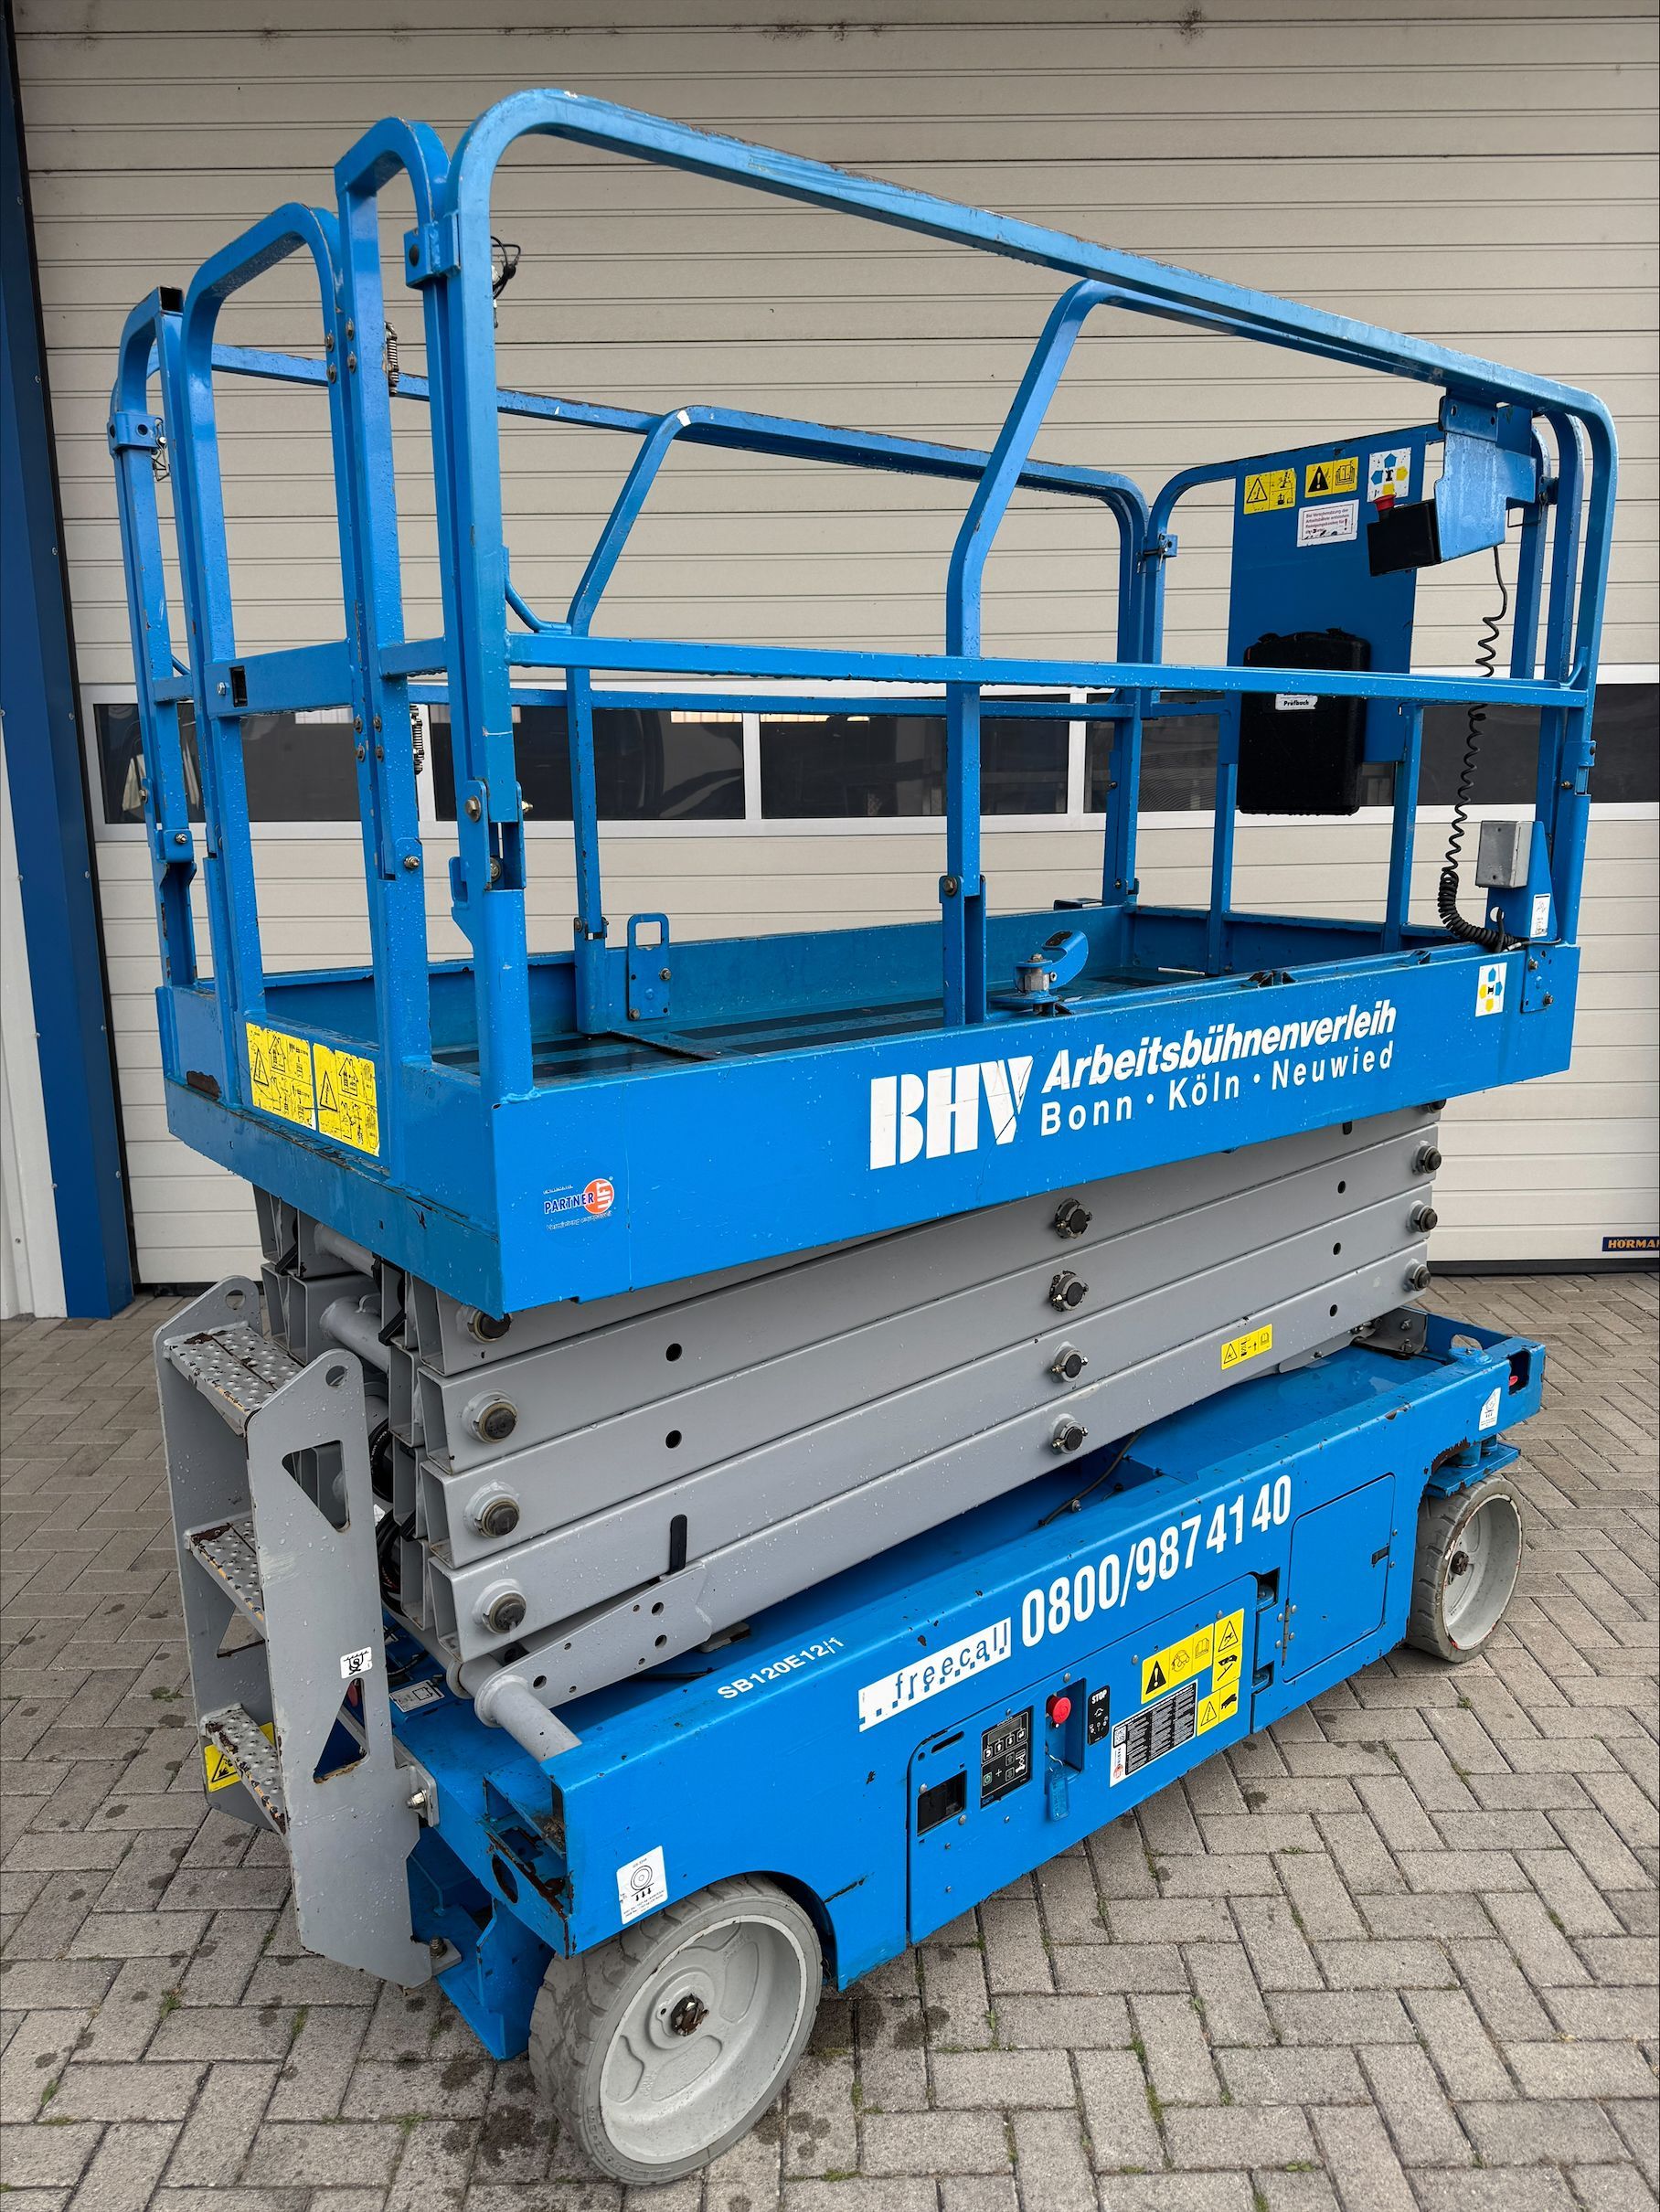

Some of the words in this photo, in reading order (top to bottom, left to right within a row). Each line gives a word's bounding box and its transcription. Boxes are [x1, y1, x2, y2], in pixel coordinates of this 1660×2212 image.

[1040, 999, 1397, 1093] Arbeitsbühnenverleih
[869, 1055, 1033, 1170] BHV
[1040, 1096, 1133, 1137] Bonn
[1168, 1062, 1240, 1111] Köln
[1272, 1040, 1393, 1090] Neuwied
[544, 1192, 595, 1214] PARTNER
[596, 1182, 612, 1209] LIFT
[717, 1637, 845, 1700] SB120E12/1
[895, 1622, 1007, 1700] freecall
[1091, 1688, 1108, 1705] STOP
